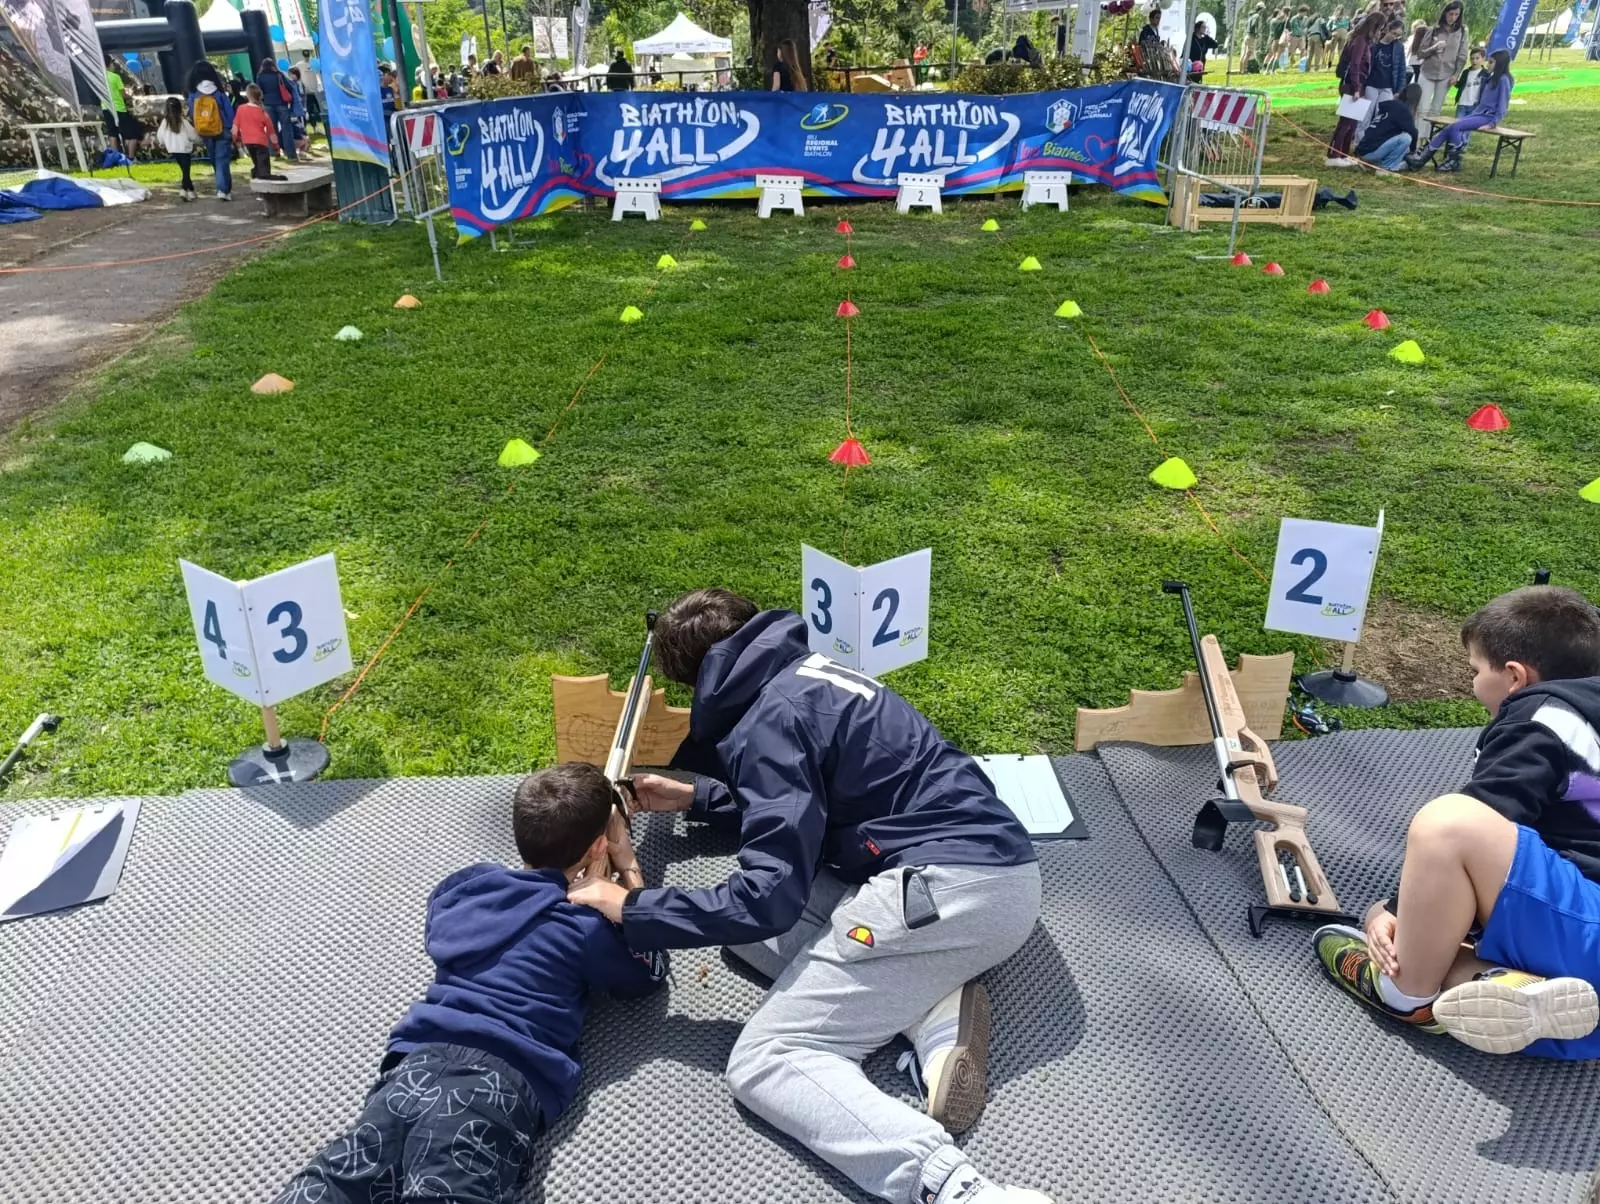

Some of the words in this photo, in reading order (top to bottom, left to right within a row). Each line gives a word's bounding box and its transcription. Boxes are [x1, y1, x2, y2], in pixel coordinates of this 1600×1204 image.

[609, 127, 720, 176] 4ALL
[805, 139, 839, 147] REGIONAL
[870, 127, 979, 177] 4ALL
[480, 143, 534, 207] 4ALL
[779, 192, 785, 205] 3
[917, 190, 924, 202] 2
[811, 577, 833, 635] 3
[1285, 548, 1328, 606] 2
[203, 599, 228, 661] 4
[266, 600, 309, 664] 3
[872, 587, 900, 648] 2
